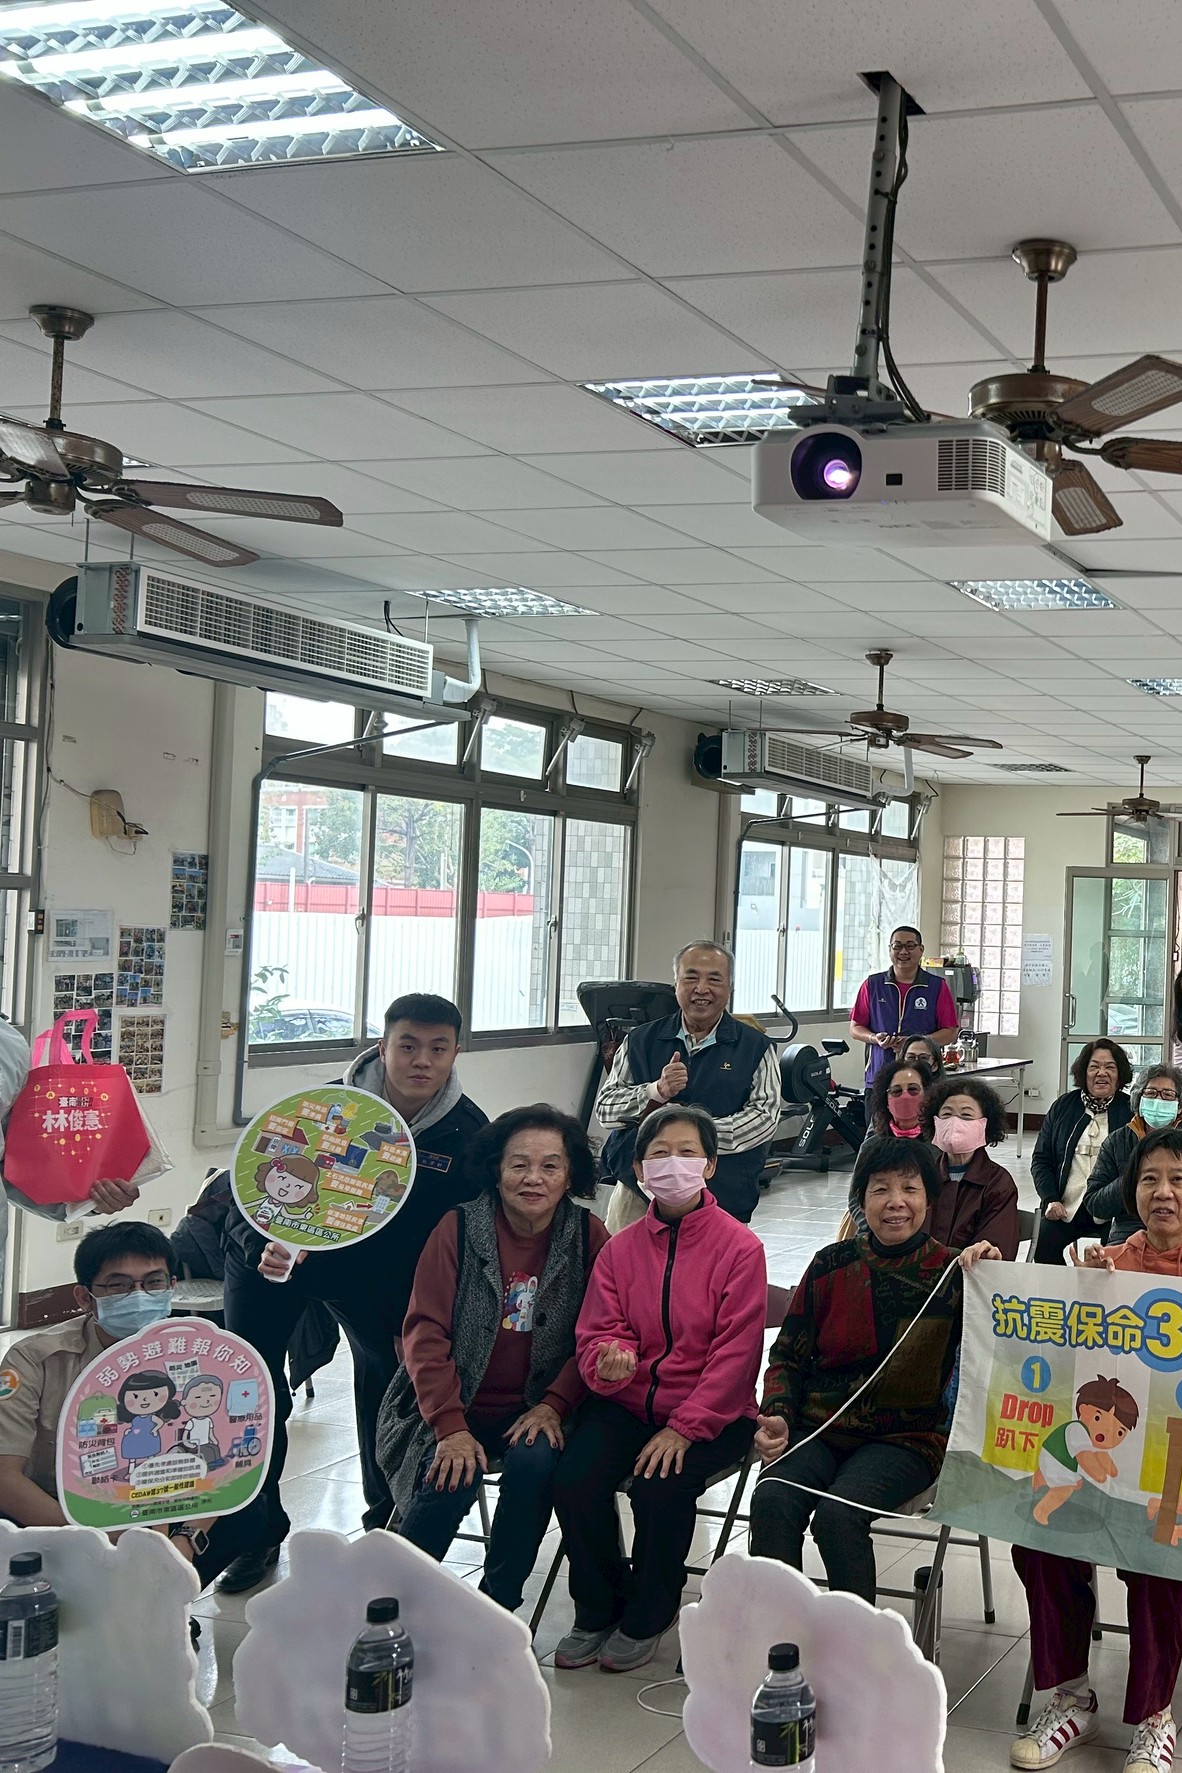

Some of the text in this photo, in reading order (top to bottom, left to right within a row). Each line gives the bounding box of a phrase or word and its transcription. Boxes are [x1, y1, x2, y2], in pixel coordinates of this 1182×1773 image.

[824, 1097, 843, 1118] SOLE
[42, 1109, 103, 1133] 林俊憲
[274, 1215, 342, 1242] 臺南市東區區公所
[95, 1336, 252, 1387] 弱勢避難報你知
[1029, 1361, 1041, 1389] 1
[1000, 1393, 1055, 1428] Drop
[78, 1437, 116, 1449] 防災背包
[995, 1427, 1040, 1453] 趴下
